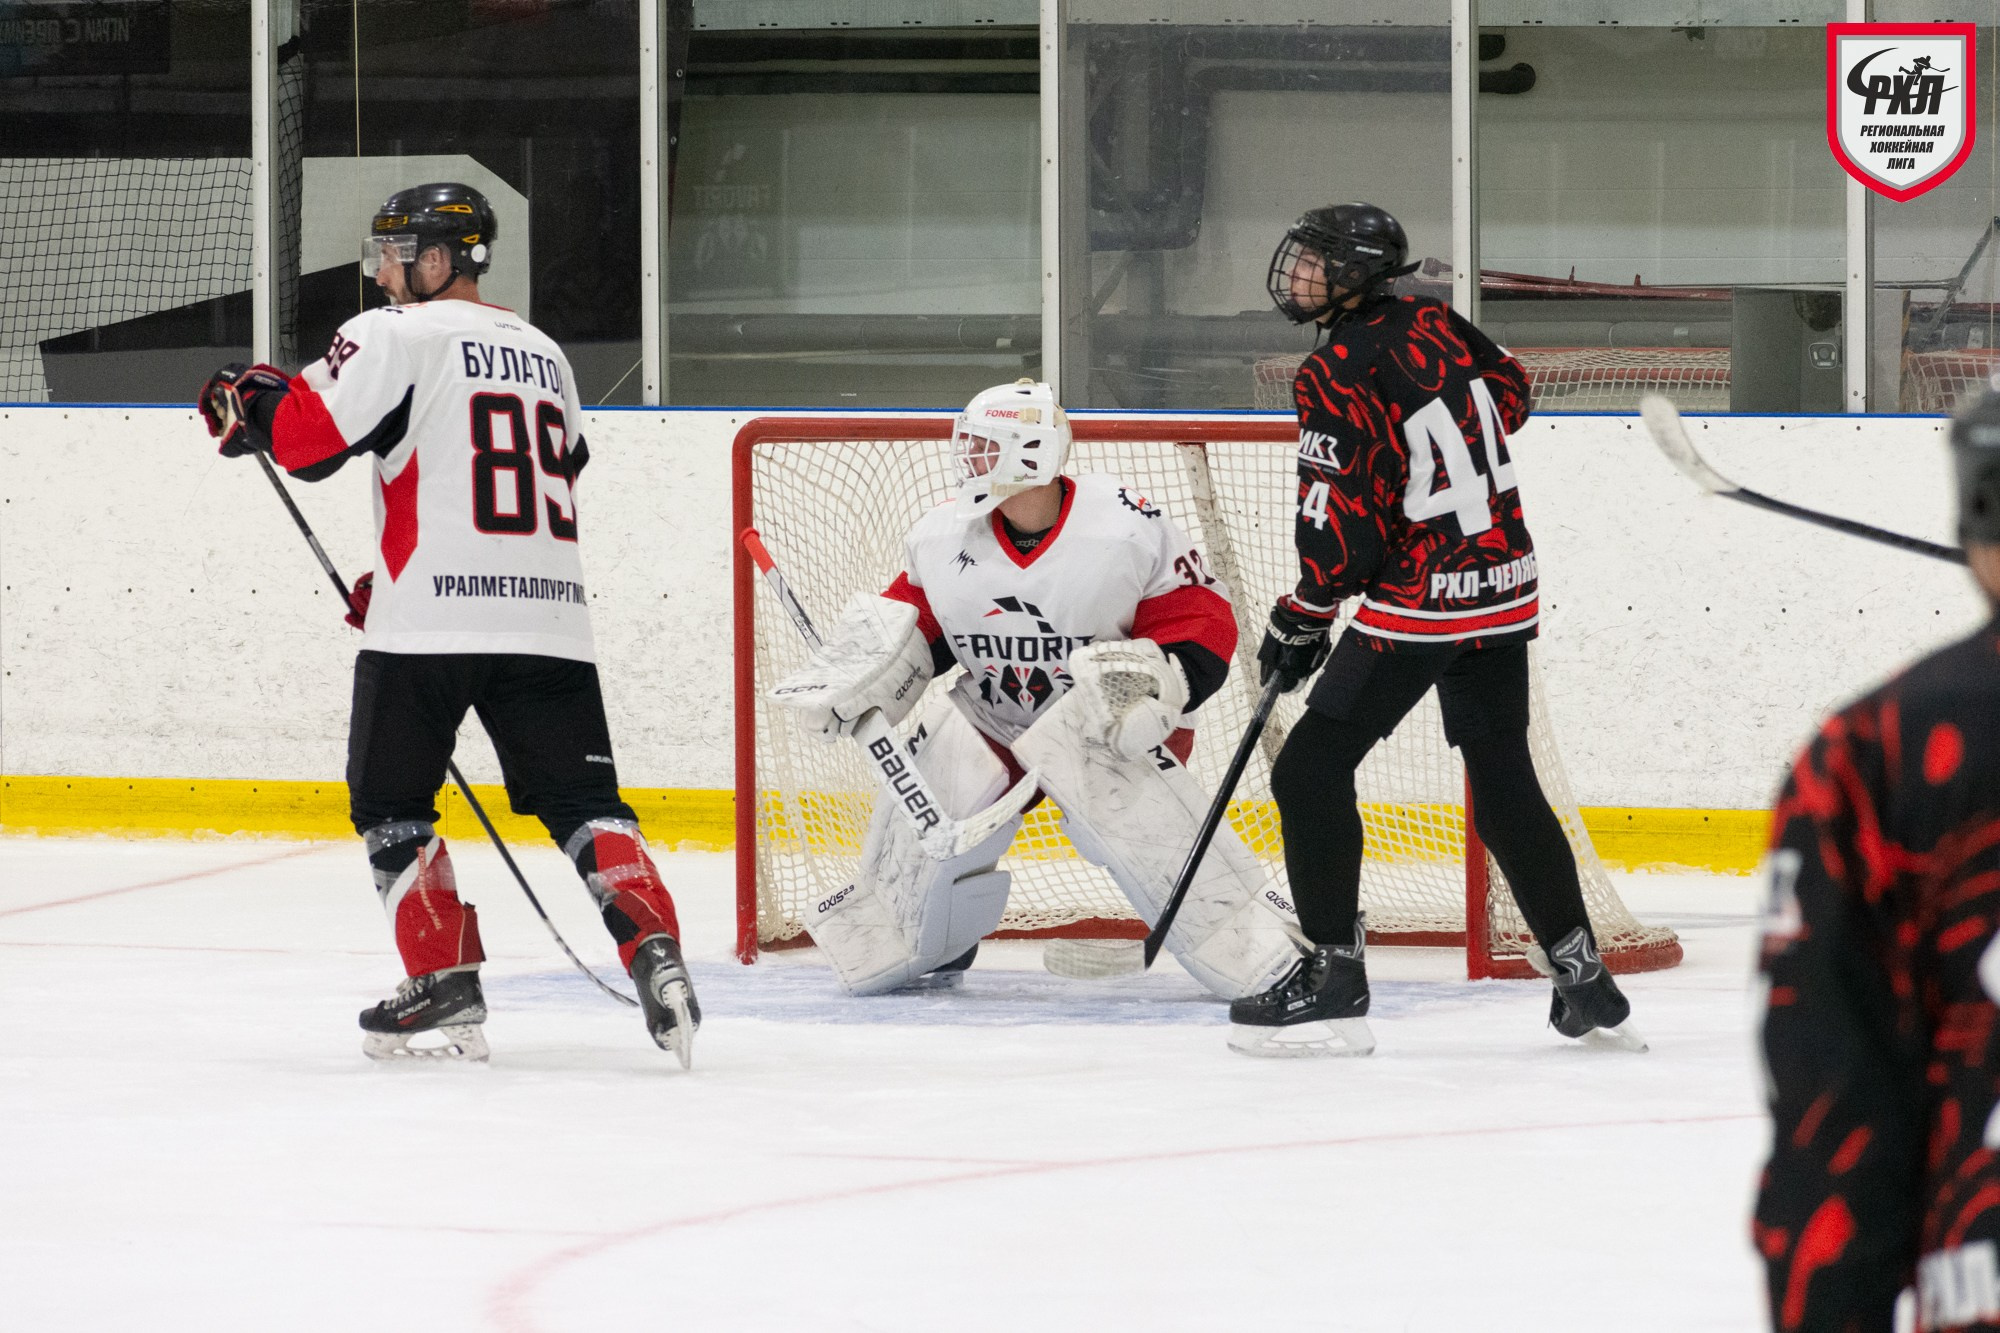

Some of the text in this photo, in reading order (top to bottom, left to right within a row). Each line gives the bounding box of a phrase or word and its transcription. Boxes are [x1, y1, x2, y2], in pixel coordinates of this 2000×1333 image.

[461, 341, 565, 400] БУЛАТО
[985, 409, 1020, 418] FONBE
[469, 391, 578, 543] 89
[1403, 377, 1518, 536] 44
[1298, 476, 1330, 531] 4
[774, 683, 829, 696] CCM
